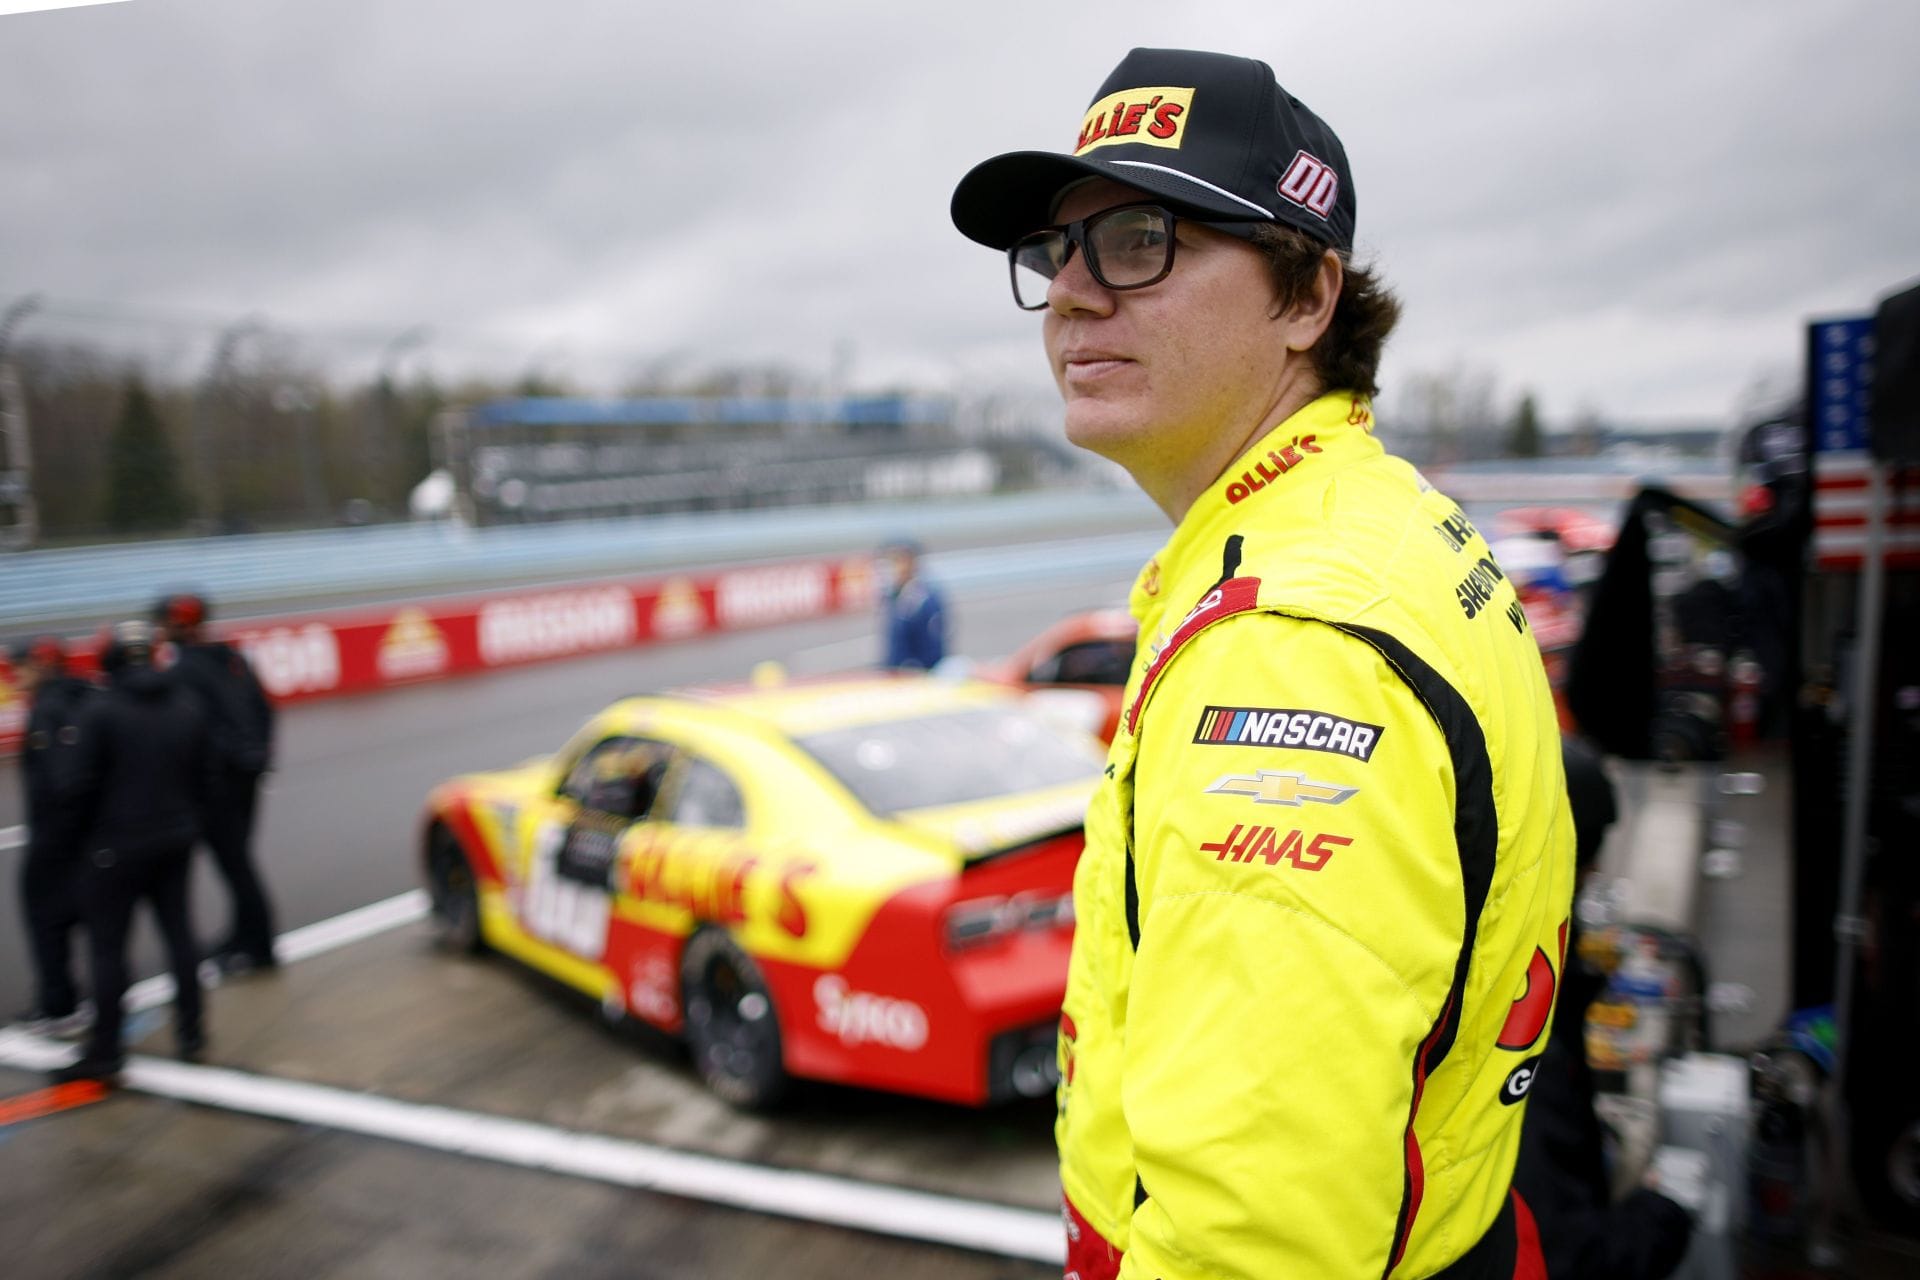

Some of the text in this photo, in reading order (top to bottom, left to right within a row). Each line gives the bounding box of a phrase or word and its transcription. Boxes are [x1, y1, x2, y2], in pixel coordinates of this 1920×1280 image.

[1073, 96, 1184, 152] LLIE'S
[1225, 434, 1324, 505] OLLIE'S
[1239, 711, 1375, 758] NASCAR
[1200, 824, 1354, 872] HAAS
